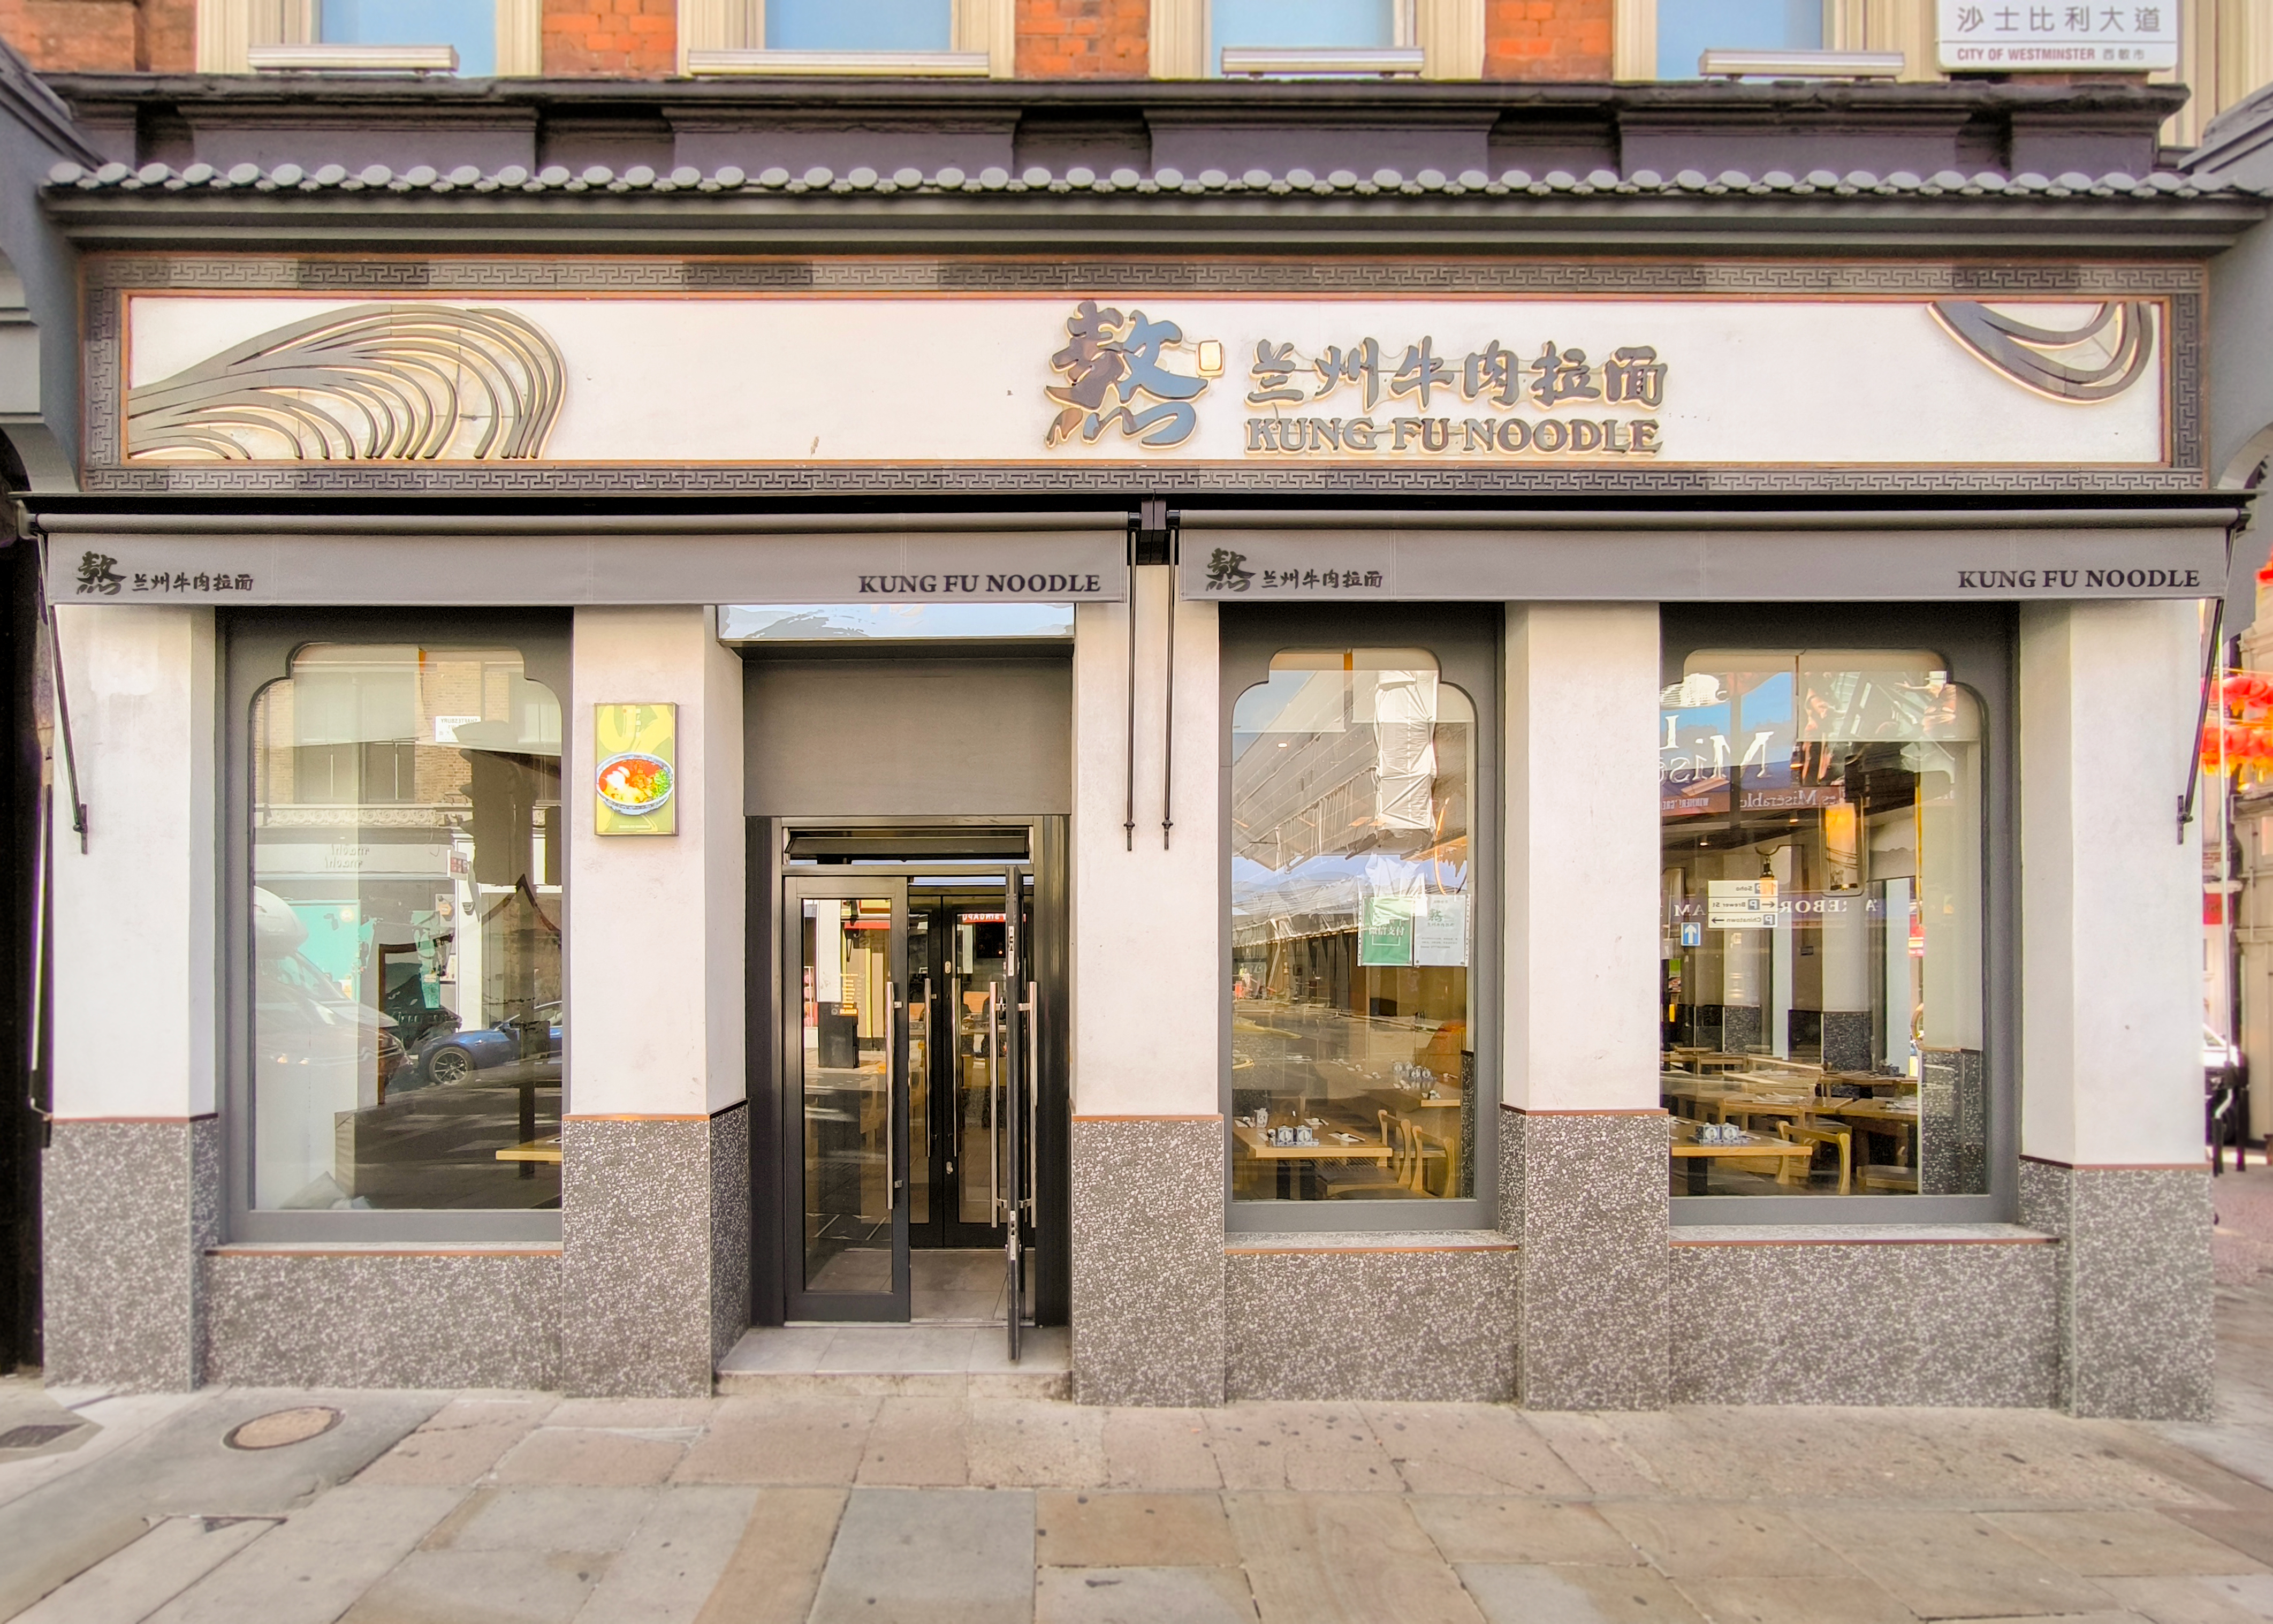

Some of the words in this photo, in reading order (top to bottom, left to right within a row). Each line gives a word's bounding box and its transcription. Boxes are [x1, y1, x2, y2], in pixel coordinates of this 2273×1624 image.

[1957, 6, 2161, 32] 沙士比利大道
[1957, 48, 1983, 61] CITY
[1988, 48, 2003, 60] OF
[2008, 48, 2095, 60] WESTMINSTER
[1243, 336, 1668, 412] 兰州牛肉拉面
[1245, 418, 1377, 456] KUNG
[1392, 418, 1449, 456] FU
[1463, 418, 1663, 456] NOODLE
[131, 572, 255, 594] 兰州牛肉拉面
[858, 575, 938, 594] KUNG
[944, 575, 979, 594] FU
[985, 575, 1101, 594] NOODLE
[1262, 570, 1383, 590] 兰州牛肉拉面
[1958, 569, 2036, 589] KUNG
[2043, 569, 2079, 589] FU
[2085, 569, 2200, 589] NOODLE
